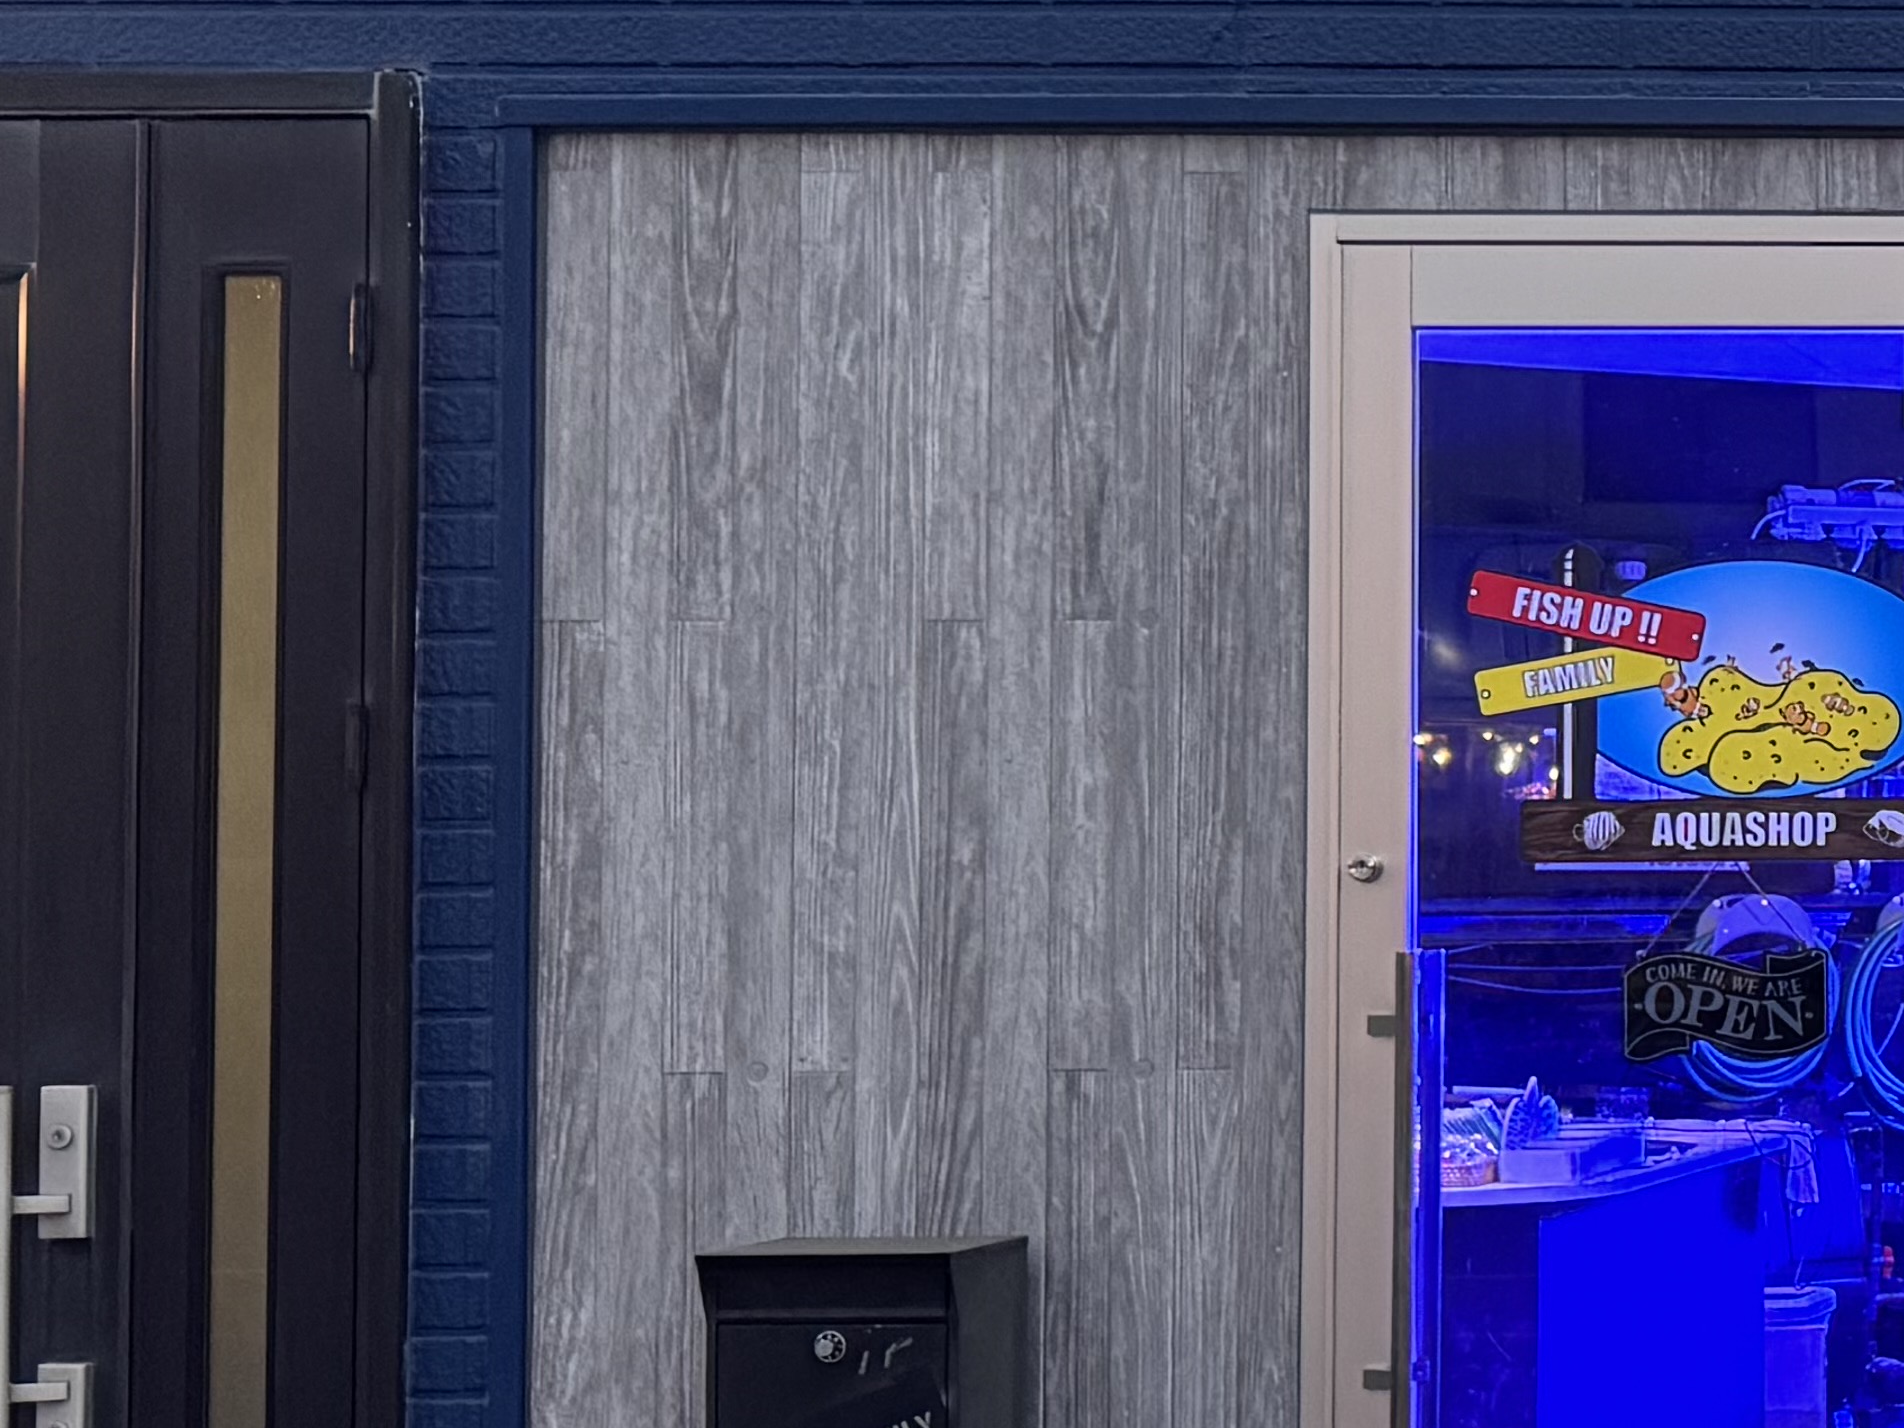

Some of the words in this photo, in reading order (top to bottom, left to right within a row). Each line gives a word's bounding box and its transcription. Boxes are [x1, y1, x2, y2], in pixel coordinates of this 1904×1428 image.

[1511, 586, 1585, 631] FISH
[1588, 602, 1634, 638] UP
[1522, 655, 1616, 698] FAMILY
[1651, 811, 1837, 851] AQUASHOP
[1645, 962, 1698, 983] COME
[1732, 975, 1760, 995] WE
[1763, 977, 1804, 997] ARE
[1643, 980, 1807, 1042] OPEN
